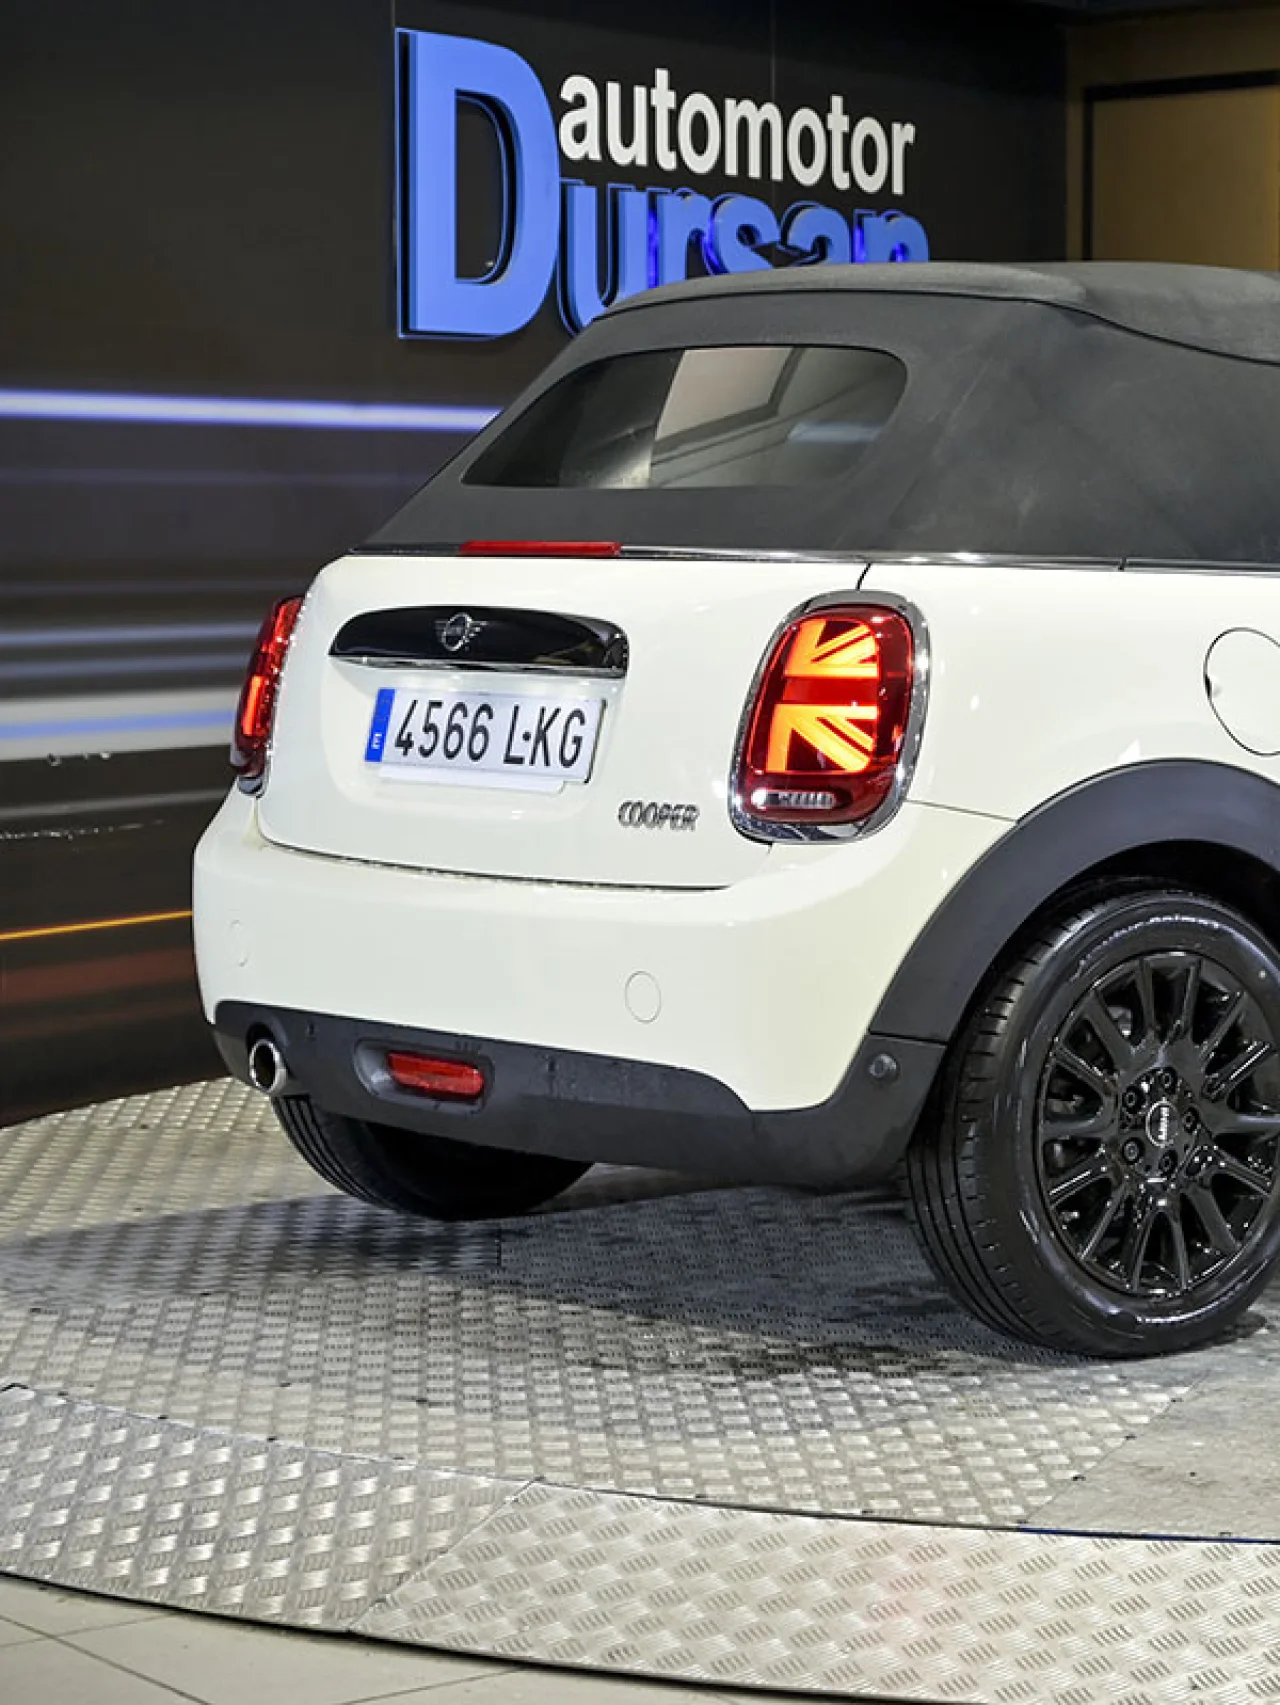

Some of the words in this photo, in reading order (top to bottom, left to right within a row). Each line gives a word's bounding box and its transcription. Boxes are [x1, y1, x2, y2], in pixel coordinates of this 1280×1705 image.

[558, 68, 915, 195] automotor
[394, 700, 494, 762] 4566
[618, 799, 700, 830] COOPER
